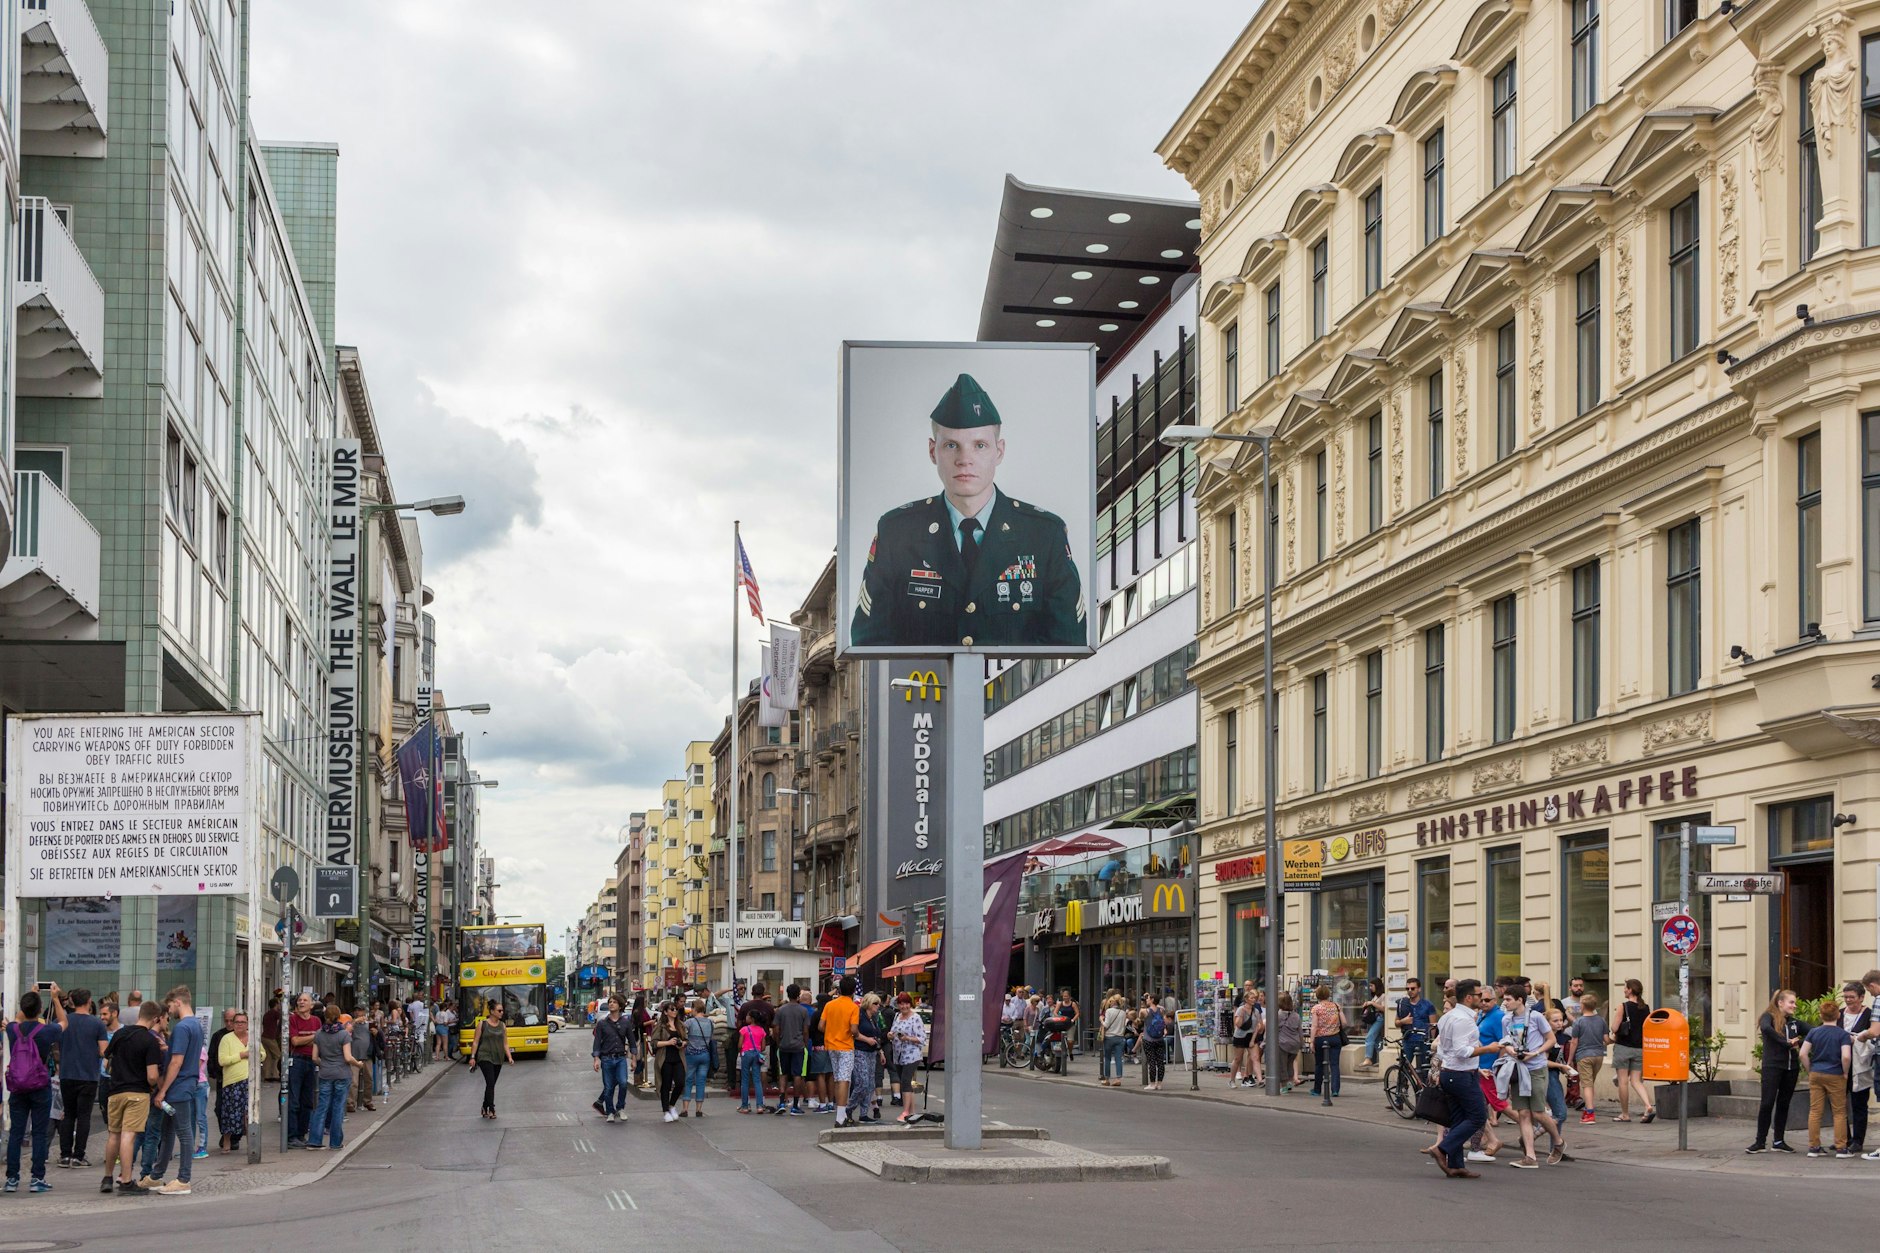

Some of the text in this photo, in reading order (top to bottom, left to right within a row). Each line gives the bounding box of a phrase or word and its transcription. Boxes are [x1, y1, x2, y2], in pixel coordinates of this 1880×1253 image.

[333, 448, 357, 506] MUR
[333, 515, 355, 540] LE
[331, 553, 355, 621] WALL
[914, 586, 934, 595] HARPER
[330, 629, 353, 673] THE
[34, 726, 234, 739] YOU ARE ENTERING THE AMERICAN SECTOR
[33, 740, 233, 752] CARRYING WEAPONS OFF DUTY FORBIDDEN
[86, 754, 184, 765] OBEY TRAFFIC RULES
[40, 774, 53, 784] ВЫ
[111, 773, 116, 783] В
[122, 770, 195, 783] АМЕРИКАНСКИЙ
[200, 772, 232, 782] СЕКТОР
[913, 713, 934, 850] McDonalds
[31, 787, 60, 798] НОСИТЬ
[63, 787, 94, 798] ОРУЖИЕ
[147, 786, 152, 796] В
[214, 786, 238, 796] ВРЕМЯ
[114, 800, 168, 810] ДОРОЖНЫМ
[175, 799, 224, 809] ПРАВИЛАМ
[1416, 765, 1698, 847] EINSTEIN KAFFEE
[31, 821, 55, 832] VOUS
[61, 821, 94, 831] ENTREZ
[100, 820, 124, 830] DANS
[129, 820, 137, 830] LE
[143, 819, 182, 830] SECTEUR
[30, 832, 239, 846] DEFENSE DE PORTER DES ARMES EN DEHORS DU SERVICE
[1354, 828, 1385, 856] GIFTS
[92, 848, 111, 859] AUX
[116, 847, 148, 858] REGLES
[154, 847, 164, 857] DE
[170, 846, 227, 856] CIRCULATION
[1284, 860, 1320, 869] Werben
[30, 864, 237, 880] SIE BETRETEN DEN AMERIKANISCHEN SEKTOR
[1284, 871, 1320, 879] Laternen!
[757, 912, 776, 920] CHECKPOINT
[1320, 936, 1369, 960] BERLIN LOVERS
[482, 967, 522, 978] City Circle
